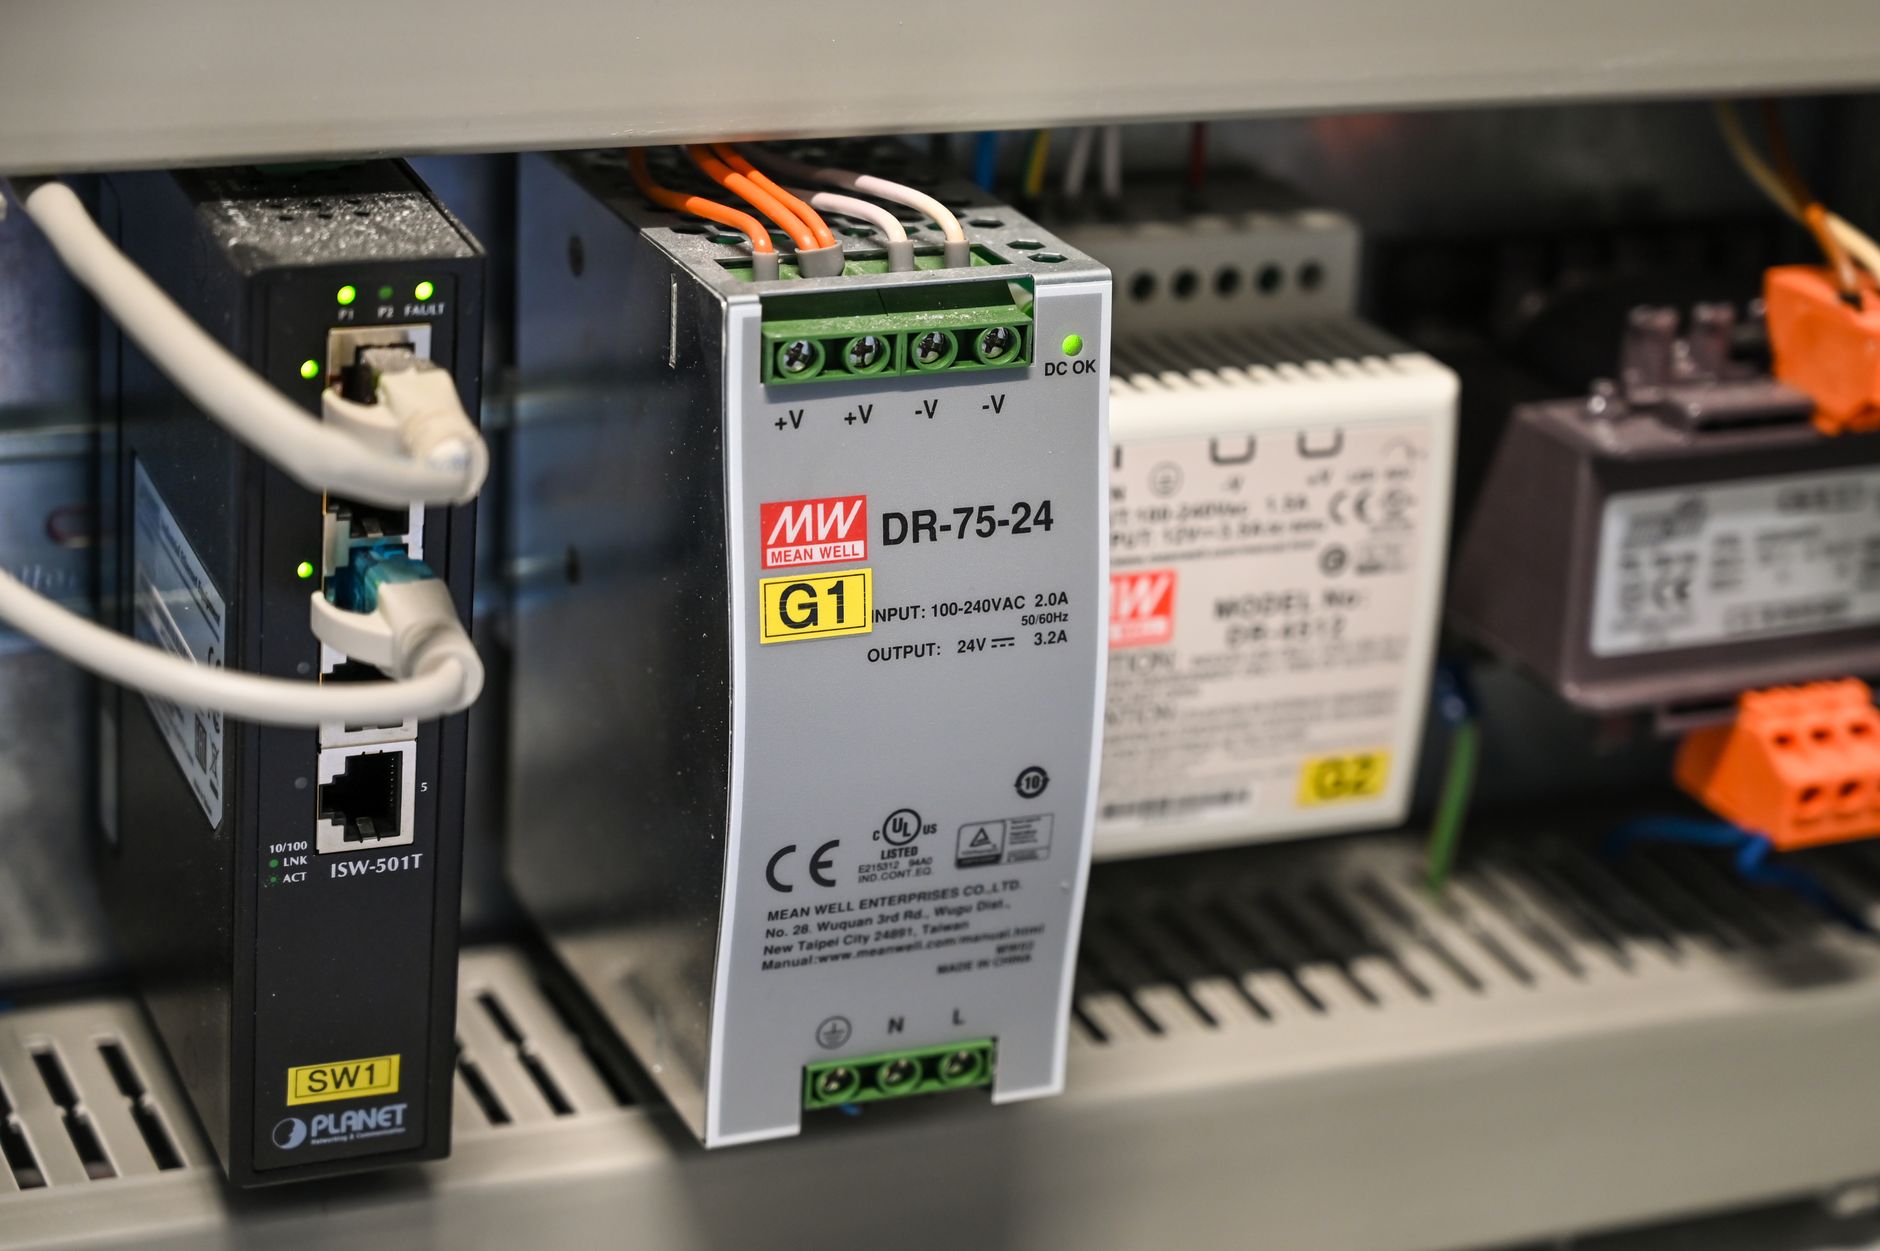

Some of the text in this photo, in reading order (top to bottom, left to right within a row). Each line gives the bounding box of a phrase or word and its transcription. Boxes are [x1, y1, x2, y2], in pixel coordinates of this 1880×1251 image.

[338, 308, 354, 320] P1
[378, 305, 394, 318] P2
[404, 303, 445, 317] FAULT
[1044, 359, 1096, 376] DC OK
[915, 399, 938, 419] -V
[982, 394, 1006, 414] -V
[774, 409, 804, 430] +V
[844, 404, 873, 425] +V
[767, 499, 863, 545] MW
[882, 500, 1054, 546] DR-75-24
[771, 544, 860, 564] MEAN WELL
[778, 580, 845, 629] G1
[931, 595, 1025, 619] 100-240VAC
[1034, 591, 1069, 608] 2.0A
[1020, 612, 1069, 627] 50/60Hz
[867, 629, 1068, 663] OUTPUT: 24V 3.2A
[420, 782, 428, 792] 5
[1025, 774, 1040, 790] 10
[922, 824, 937, 835] US
[269, 841, 308, 854] 10/100
[881, 846, 918, 860] LISTED
[283, 855, 308, 867] LNK
[331, 854, 423, 879] ISW-501T
[765, 839, 840, 893] CE
[283, 872, 307, 883] ACT
[767, 907, 810, 922] MEAN
[814, 902, 854, 917] WELL
[859, 887, 959, 910] ENTERPRISES
[765, 927, 788, 940] No.
[817, 918, 873, 936] Wuquan
[877, 913, 899, 926] 3rd
[934, 903, 973, 918] Wugu
[763, 943, 794, 957] New
[798, 937, 839, 955] Taipei
[843, 931, 869, 947] City
[922, 920, 969, 936] Taiwan
[887, 1015, 905, 1035] N
[952, 1008, 966, 1026] L
[307, 1063, 375, 1093] SW1
[311, 1103, 408, 1138] PLANET
